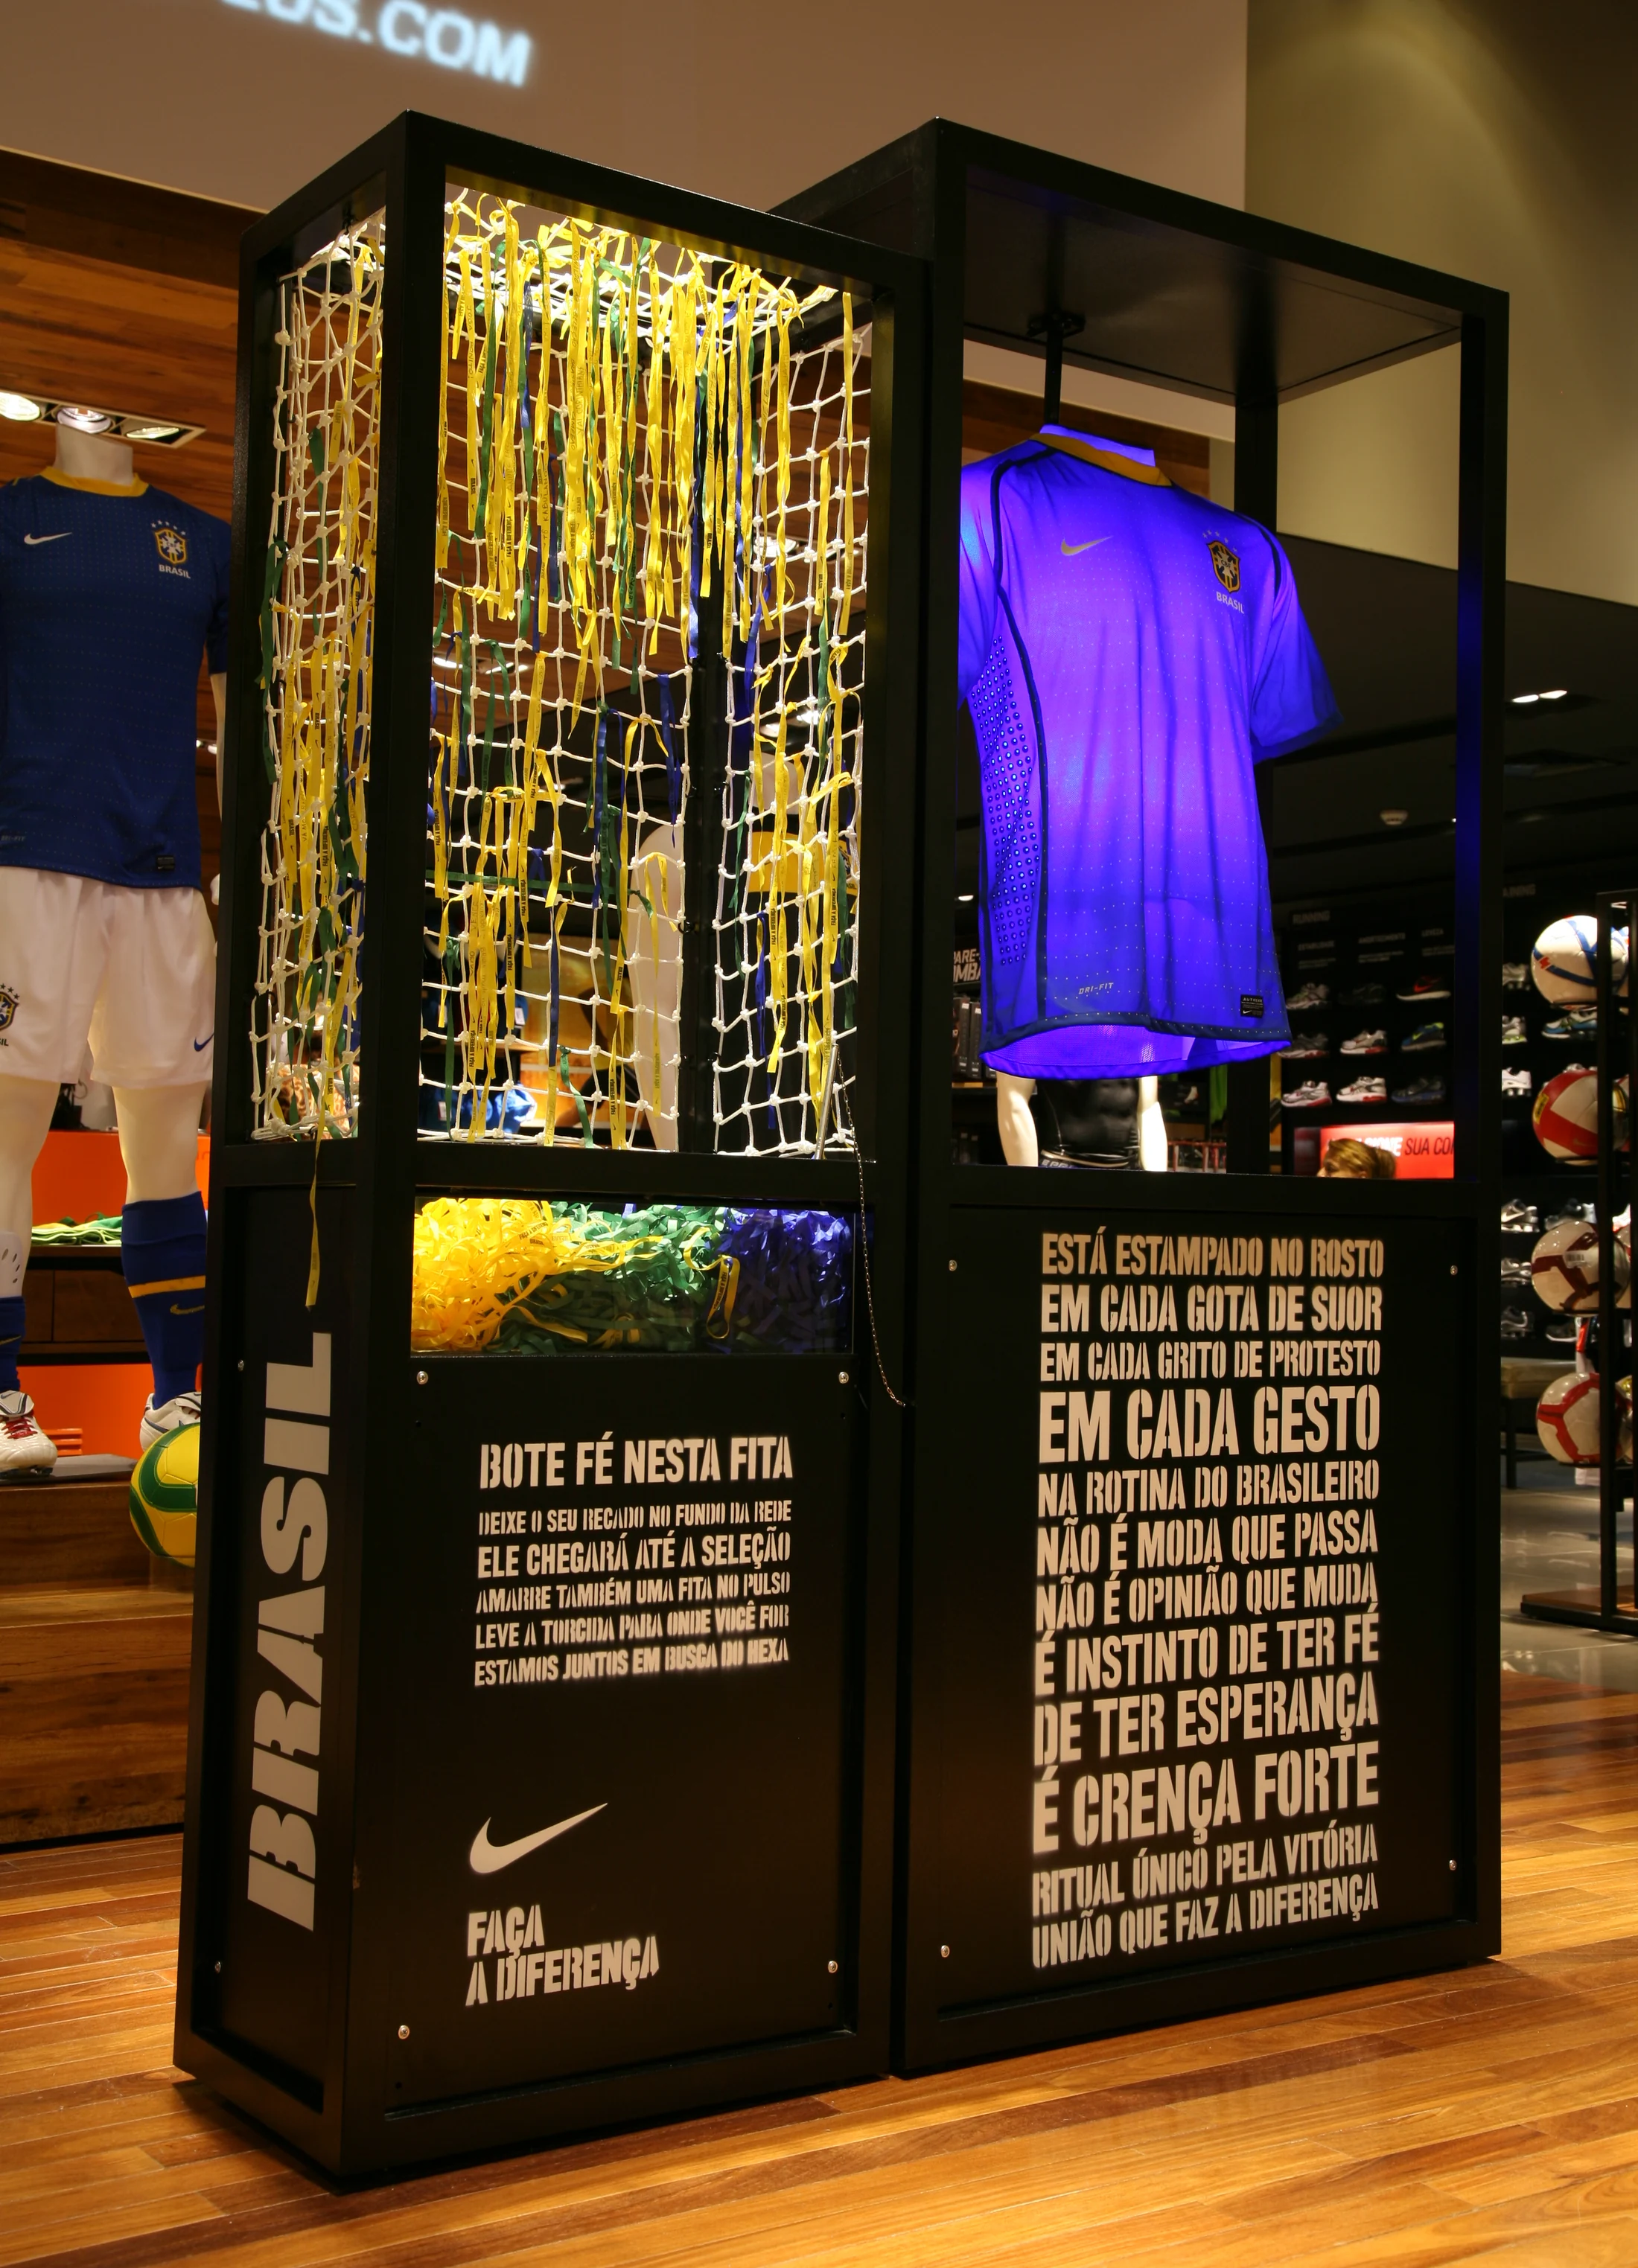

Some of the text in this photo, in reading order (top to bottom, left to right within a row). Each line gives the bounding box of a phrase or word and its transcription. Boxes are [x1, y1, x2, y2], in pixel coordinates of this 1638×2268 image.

[221, 0, 532, 87] S.COM
[159, 564, 191, 579] BRASIL
[1216, 591, 1244, 614] BRASIL
[1079, 982, 1114, 994] DRI-FIT
[1404, 1137, 1429, 1156] SUA
[1043, 1227, 1383, 1277] ESTÁ ESTAMPADO NO ROSTO
[1042, 1285, 1382, 1332] EM CADA GOTA DE SUOR
[1041, 1341, 1380, 1381] EM CADA GRITO DE PROTESTO
[1039, 1384, 1380, 1463] EM CADA GESTO
[480, 1431, 792, 1489] BOTE FÉ NESTA FITA
[1039, 1460, 1379, 1517] NA ROTINA DO BRASILEIRO
[479, 1500, 791, 1535] DEIXE O SEU RECADO NO FUNDO DA REDE
[1037, 1510, 1377, 1577] NÃO É MODA QUE PASSA
[478, 1527, 790, 1578] ELE CHEGARÁ ATÉ A SELEÇÃO
[477, 1572, 790, 1613] AMARRE TAMBÉM UMA FITA NO PULSO
[1035, 1562, 1377, 1635] NÃO É OPINIÃO QUE MUDA
[248, 1332, 331, 1931] BRASIL
[476, 1600, 788, 1649] LEVE A TORCIDA PARA ONDE VOCÊ FOR
[1035, 1603, 1378, 1697] É INSTINTO DE TER FÉ
[475, 1638, 788, 1686] ESTAMOS JUNTOS EM BUSCA DO HEXA
[1033, 1672, 1378, 1769] DE TER ESPERANÇA
[1033, 1741, 1378, 1855] É CRENÇA FORTE
[1033, 1820, 1377, 1917] RITUAL ÚNICO PELA VITÓRIA
[468, 1905, 544, 1962] FAÇA
[1033, 1873, 1378, 1968] UNIÃO QUE FAZ A DIFERENÇA
[465, 1933, 659, 2006] A DIFERENÇA
